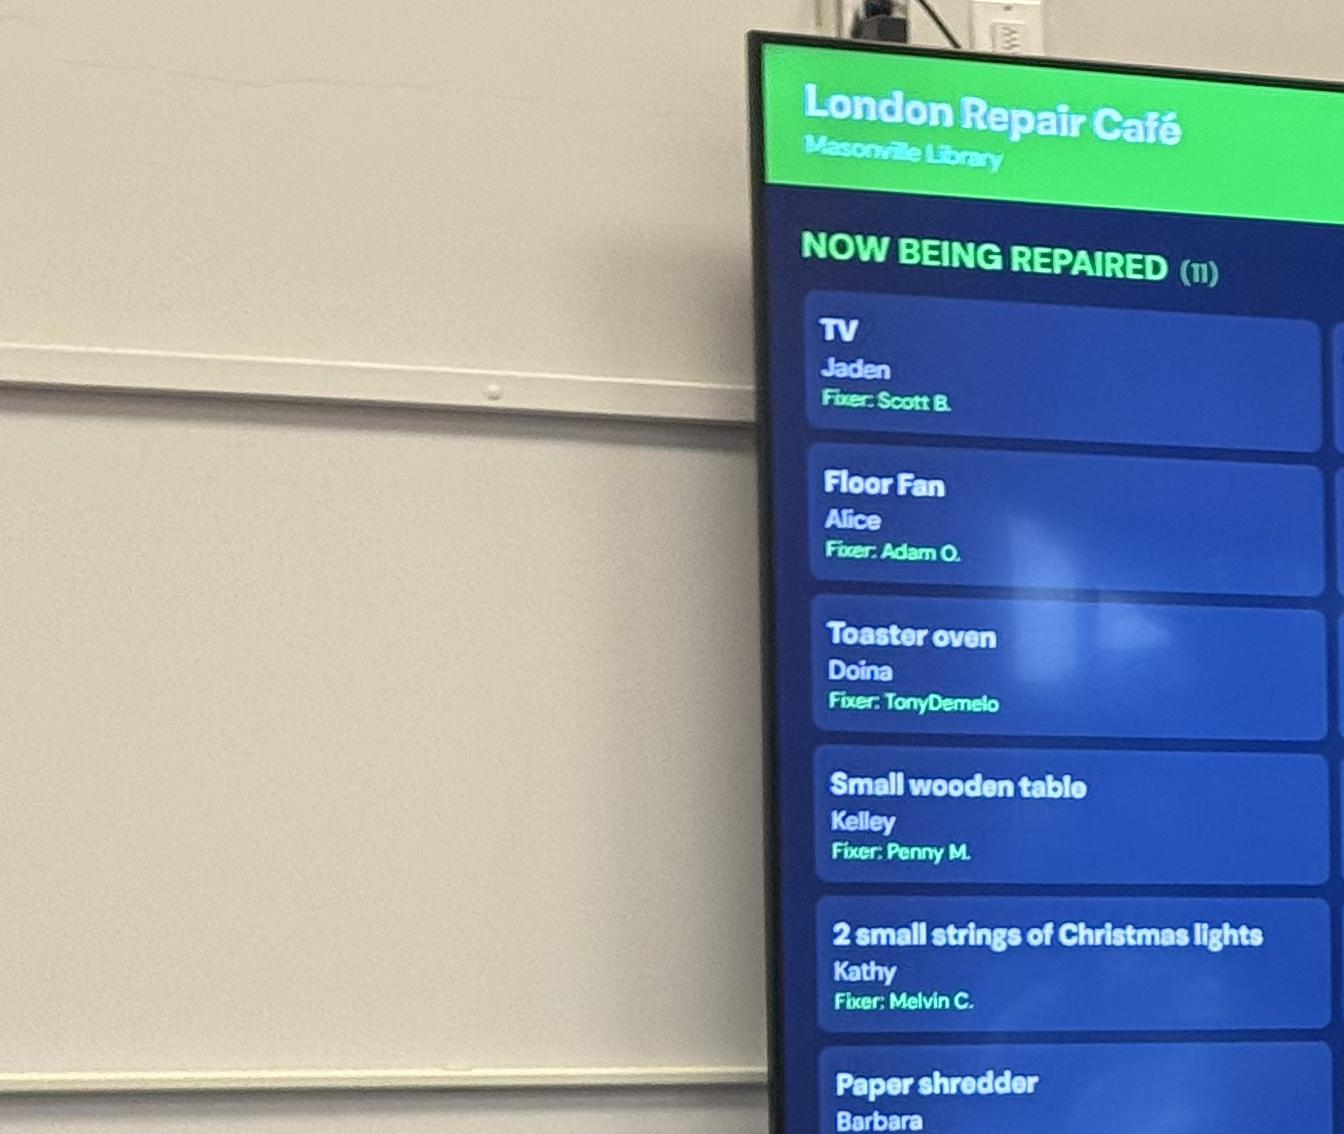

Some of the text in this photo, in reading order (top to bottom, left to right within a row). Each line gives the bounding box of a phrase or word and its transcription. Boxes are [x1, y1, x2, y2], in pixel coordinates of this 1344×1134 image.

[804, 84, 1182, 146] London Repair Café
[804, 135, 1003, 173] Masonville Library
[801, 232, 1219, 287] NOW BEING REPAIRED (11)
[819, 318, 859, 342] TV
[821, 358, 891, 380] Jaden
[824, 470, 945, 497] Floor Fan
[825, 509, 882, 530] Alice
[827, 622, 997, 648] Toaster oven
[828, 660, 893, 681] Doina
[829, 692, 999, 715] Fixer: TonyDemelo
[830, 772, 1087, 799] Small wooden table
[831, 811, 895, 836] Kelley
[832, 843, 971, 864] Fixer: Penny M.
[833, 922, 1263, 952] 2 small strings of Christmas lights
[833, 961, 896, 985] Kathy
[834, 992, 974, 1010] Fixer: Melvin C.
[836, 1071, 1039, 1101] Paper shredder
[836, 1112, 922, 1132] Barbara
